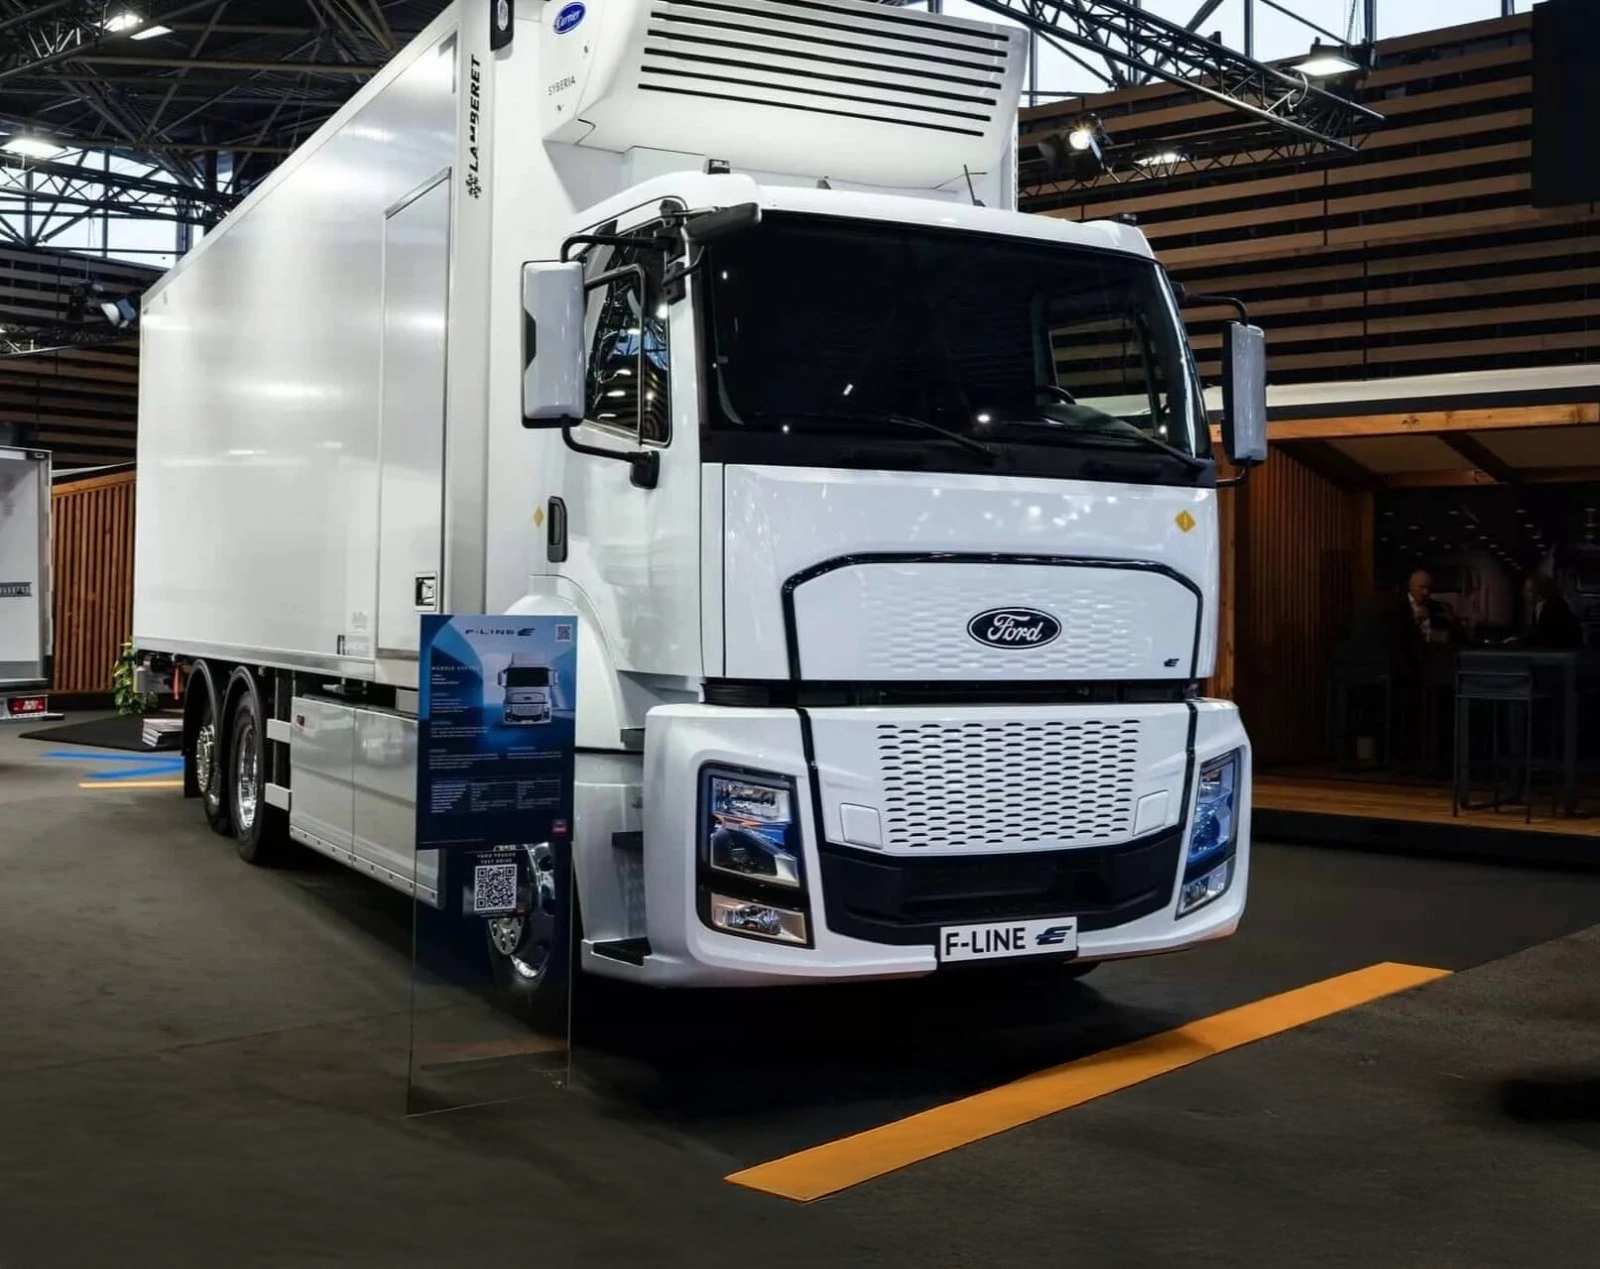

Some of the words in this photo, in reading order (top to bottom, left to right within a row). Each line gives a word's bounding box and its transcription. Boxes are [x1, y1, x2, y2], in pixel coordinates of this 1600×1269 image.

[556, 9, 581, 29] Carrier
[547, 75, 576, 96] SYBERIA
[469, 54, 481, 174] LAMBERET
[465, 628, 515, 636] F-LINE
[987, 614, 1043, 642] Ford
[946, 927, 1026, 956] F-LINE
